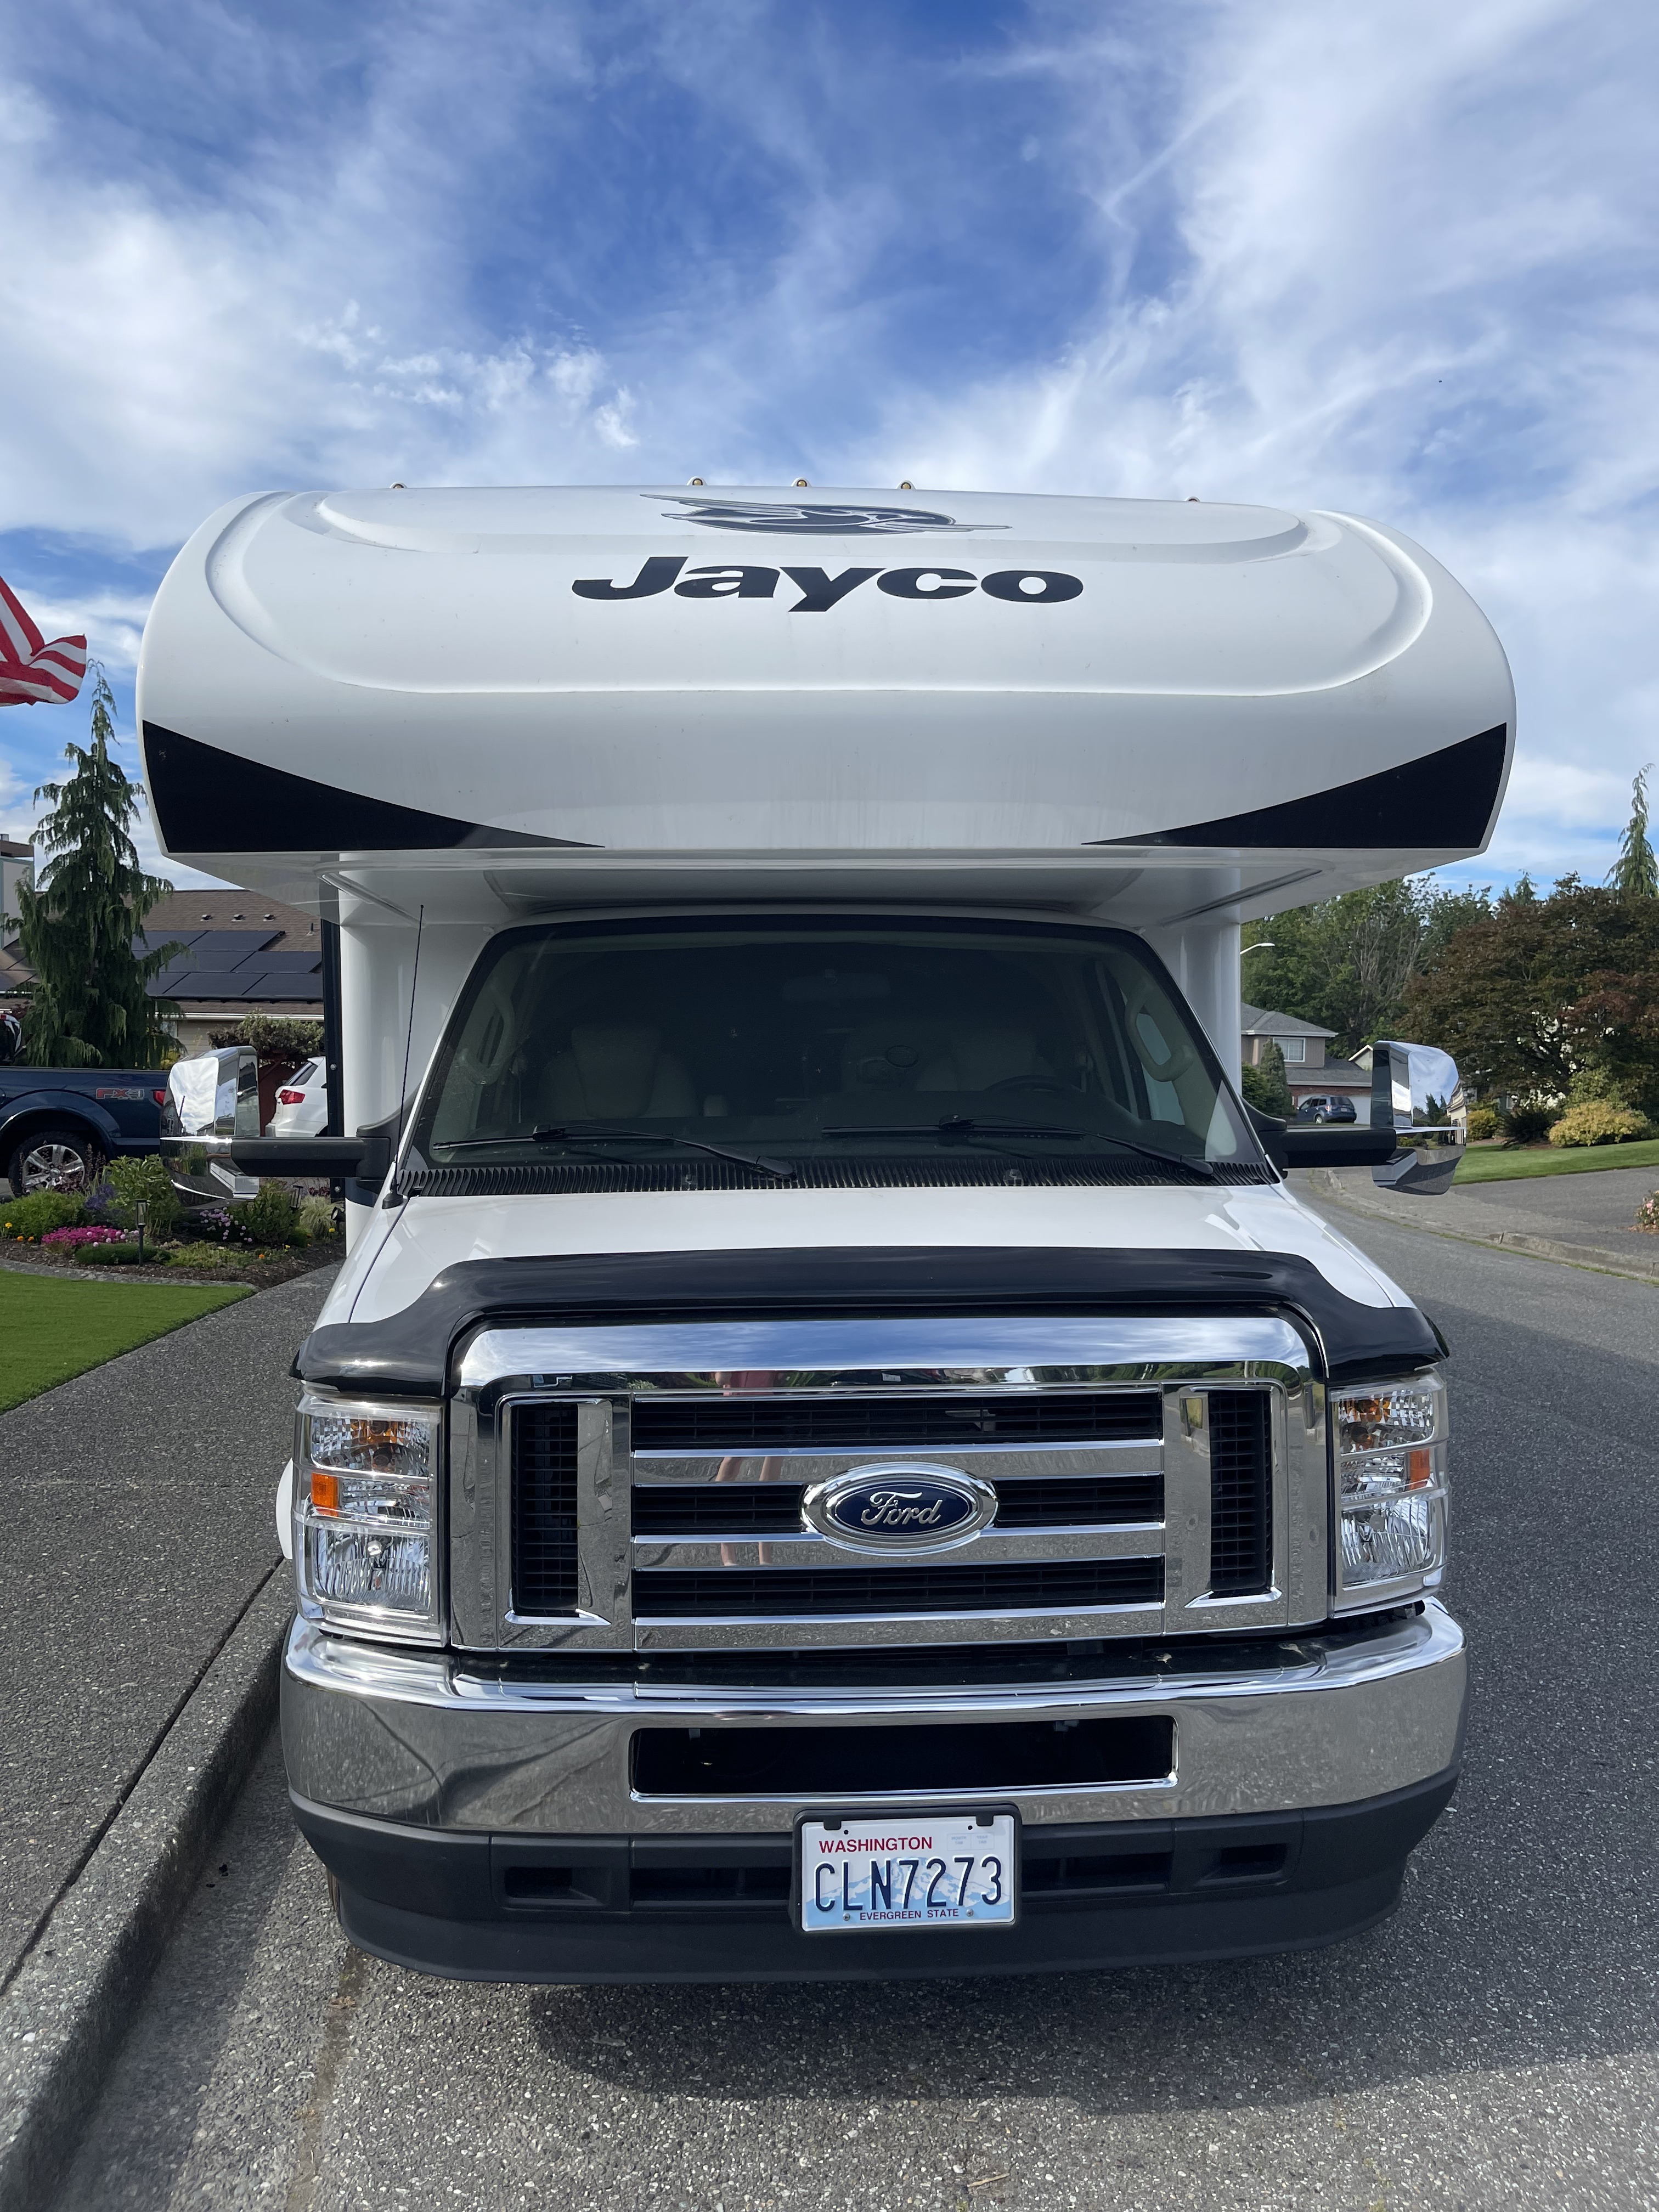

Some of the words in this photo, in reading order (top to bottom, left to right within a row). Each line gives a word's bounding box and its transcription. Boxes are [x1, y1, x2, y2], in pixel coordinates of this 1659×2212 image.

[572, 556, 1084, 612] Jayco
[96, 1088, 144, 1100] FX4
[861, 1491, 943, 1525] Ford
[819, 1836, 933, 1853] WASHINGTON
[815, 1856, 1002, 1912] CLN7273
[860, 1910, 922, 1921] EVERGREEN
[927, 1909, 960, 1918] STATE
